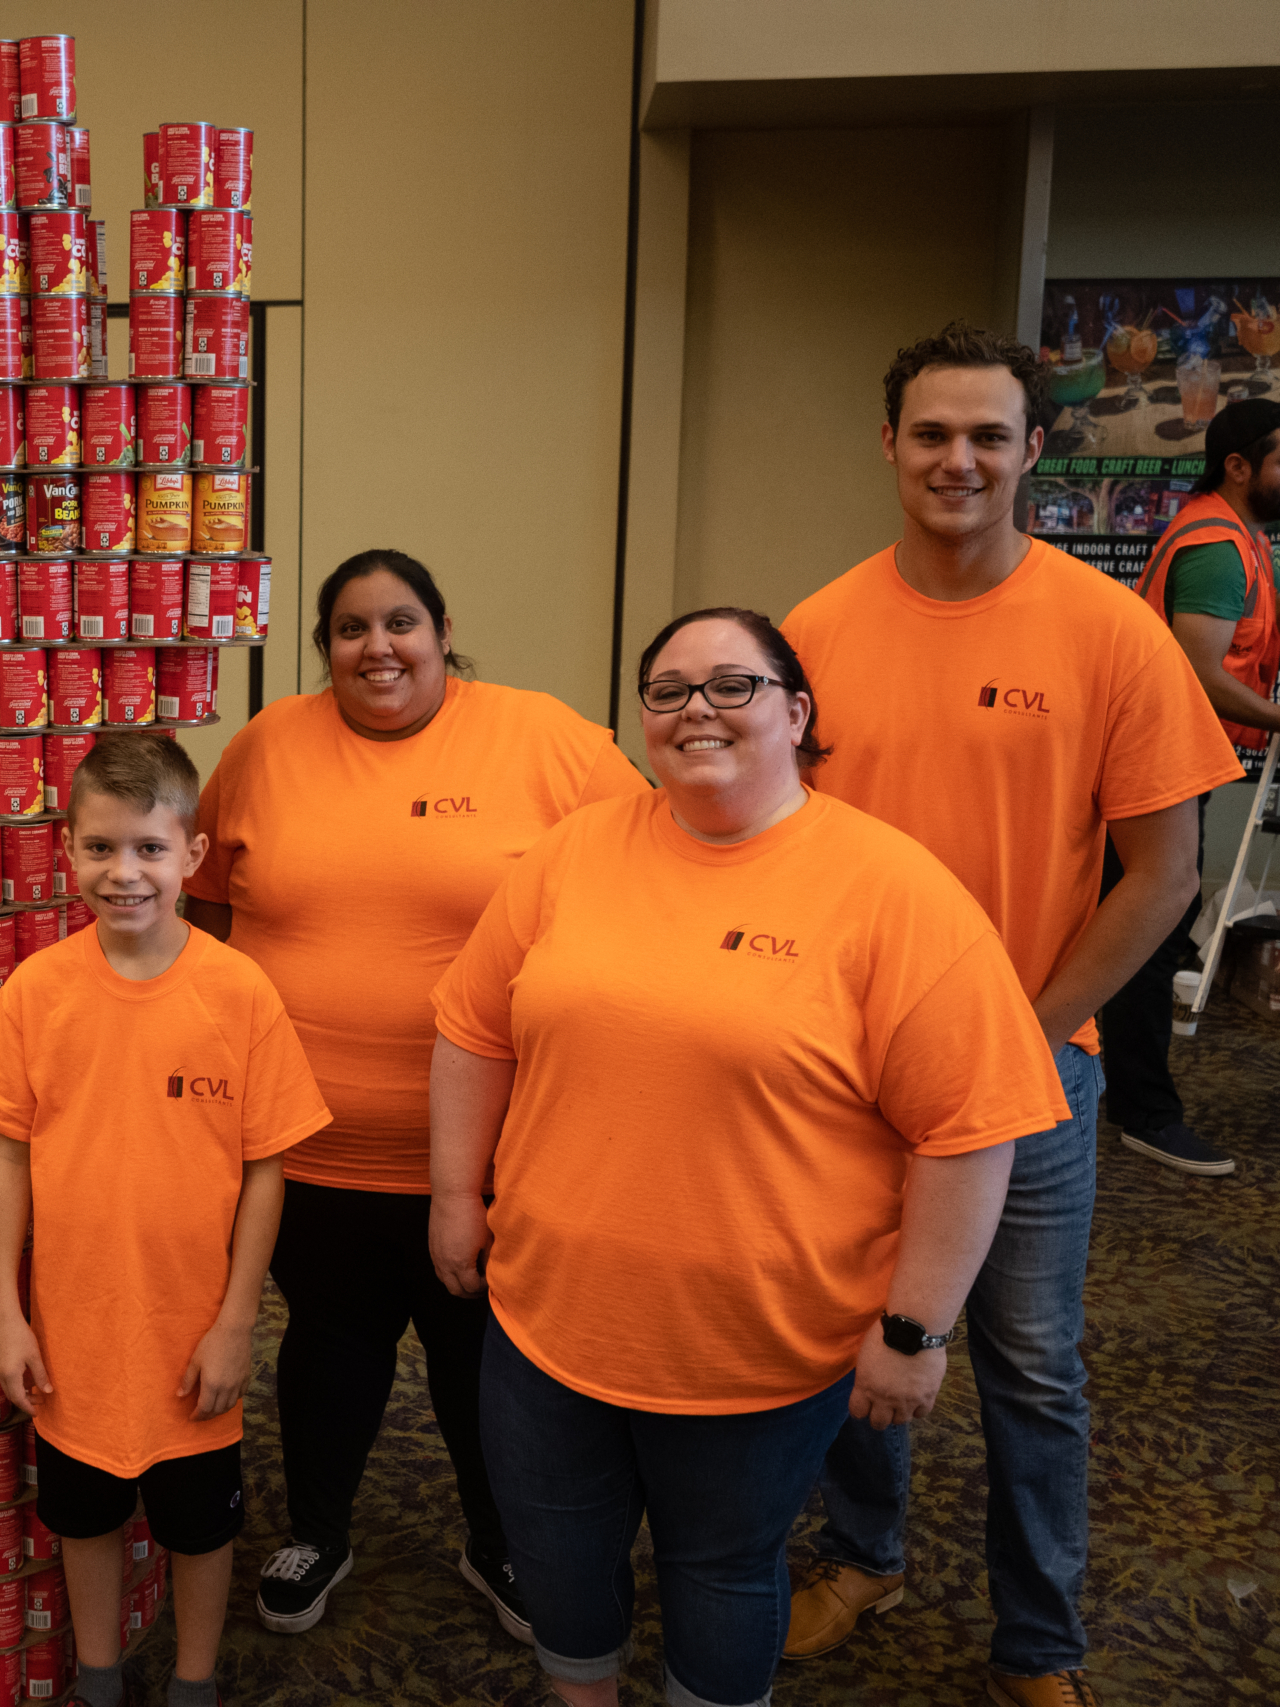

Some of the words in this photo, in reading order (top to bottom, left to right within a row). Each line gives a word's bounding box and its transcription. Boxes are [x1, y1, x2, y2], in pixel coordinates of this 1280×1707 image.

[1037, 458, 1068, 474] GREAT
[1070, 458, 1098, 475] FOOD,
[1101, 459, 1135, 474] CRAFT
[1135, 459, 1162, 474] BEER
[145, 499, 190, 509] PUMPKIN
[203, 500, 245, 510] PUMPKIN
[1072, 543, 1111, 556] INDOOR
[1115, 543, 1148, 556] CRAFT
[1003, 688, 1050, 713] CVL
[434, 796, 477, 813] CVL
[749, 934, 799, 957] CVL
[190, 1077, 234, 1100] CVL
